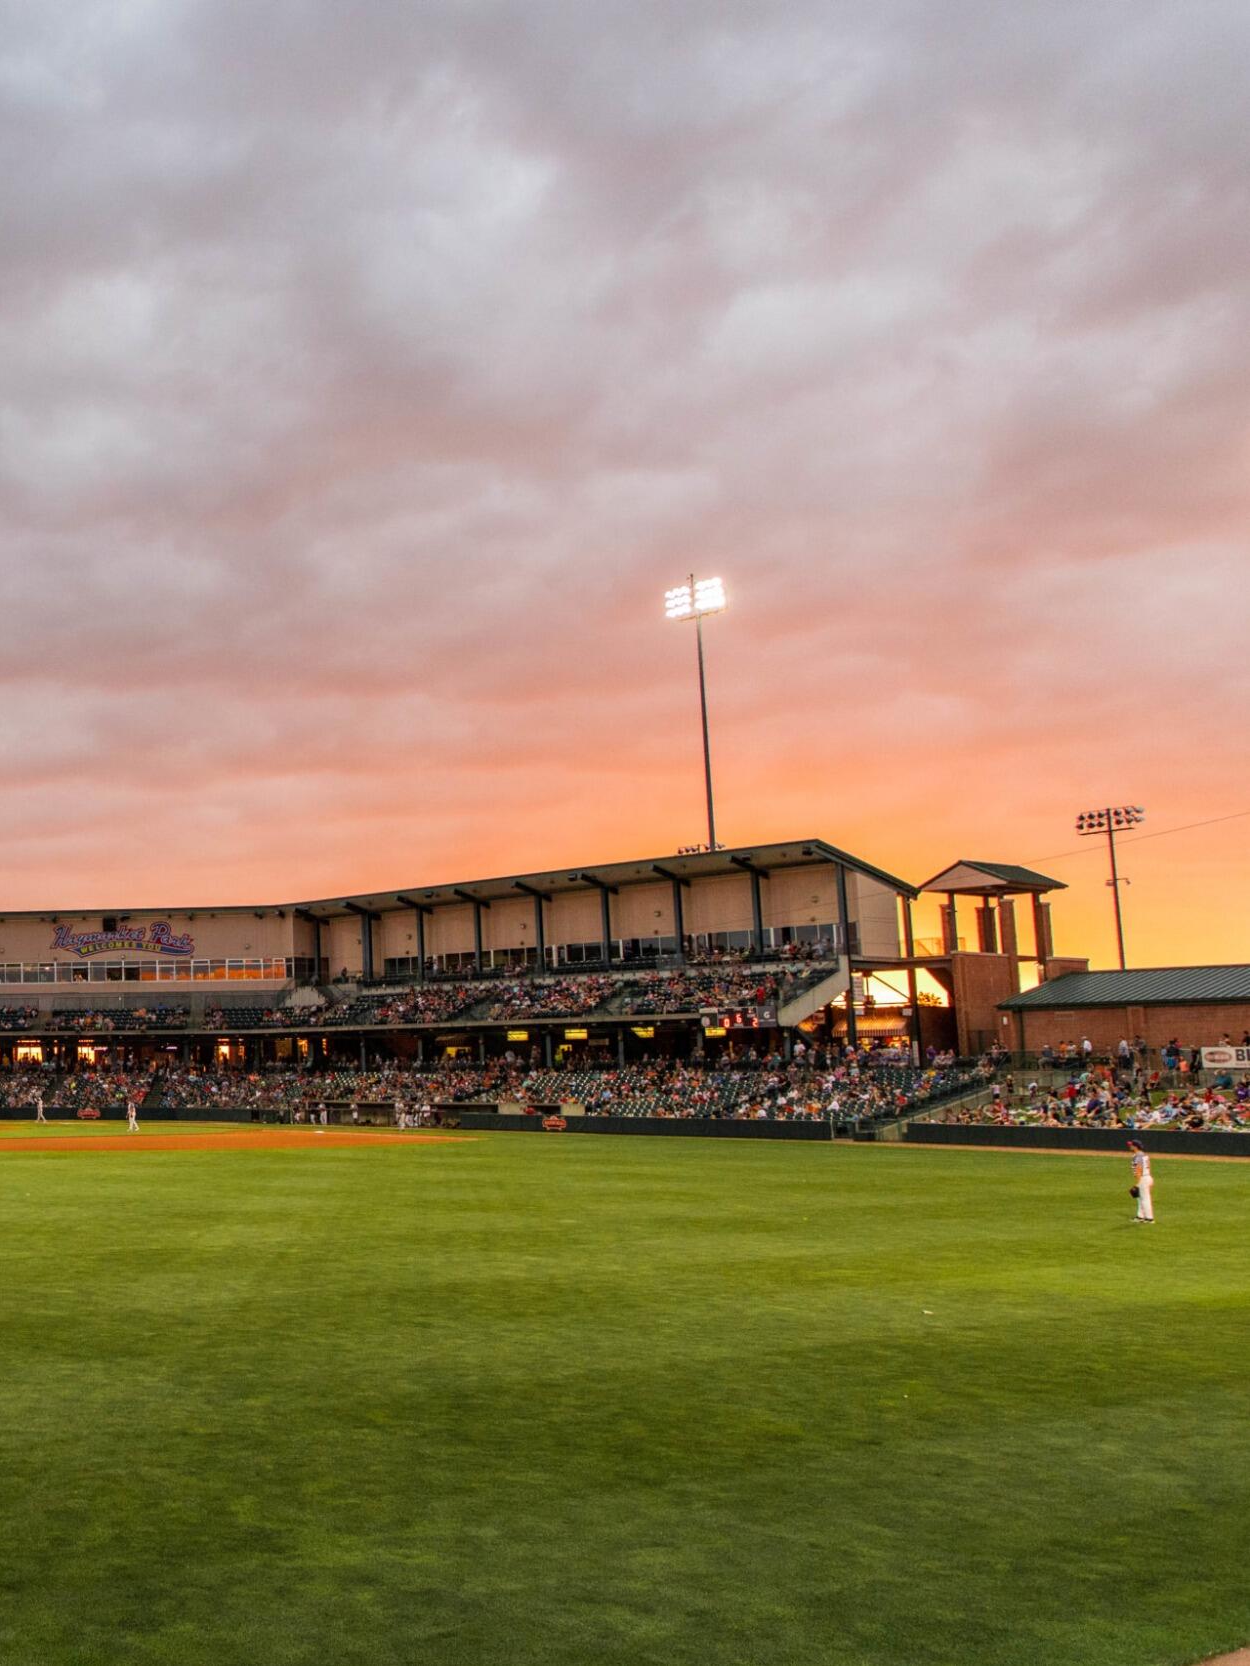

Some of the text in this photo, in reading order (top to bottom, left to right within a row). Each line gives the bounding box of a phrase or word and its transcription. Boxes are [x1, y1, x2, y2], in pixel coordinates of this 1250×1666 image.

[52, 921, 192, 948] Haymarket Park
[80, 941, 162, 953] WELCOMES YOU
[724, 1018, 730, 1028] 0
[752, 1017, 758, 1027] 2
